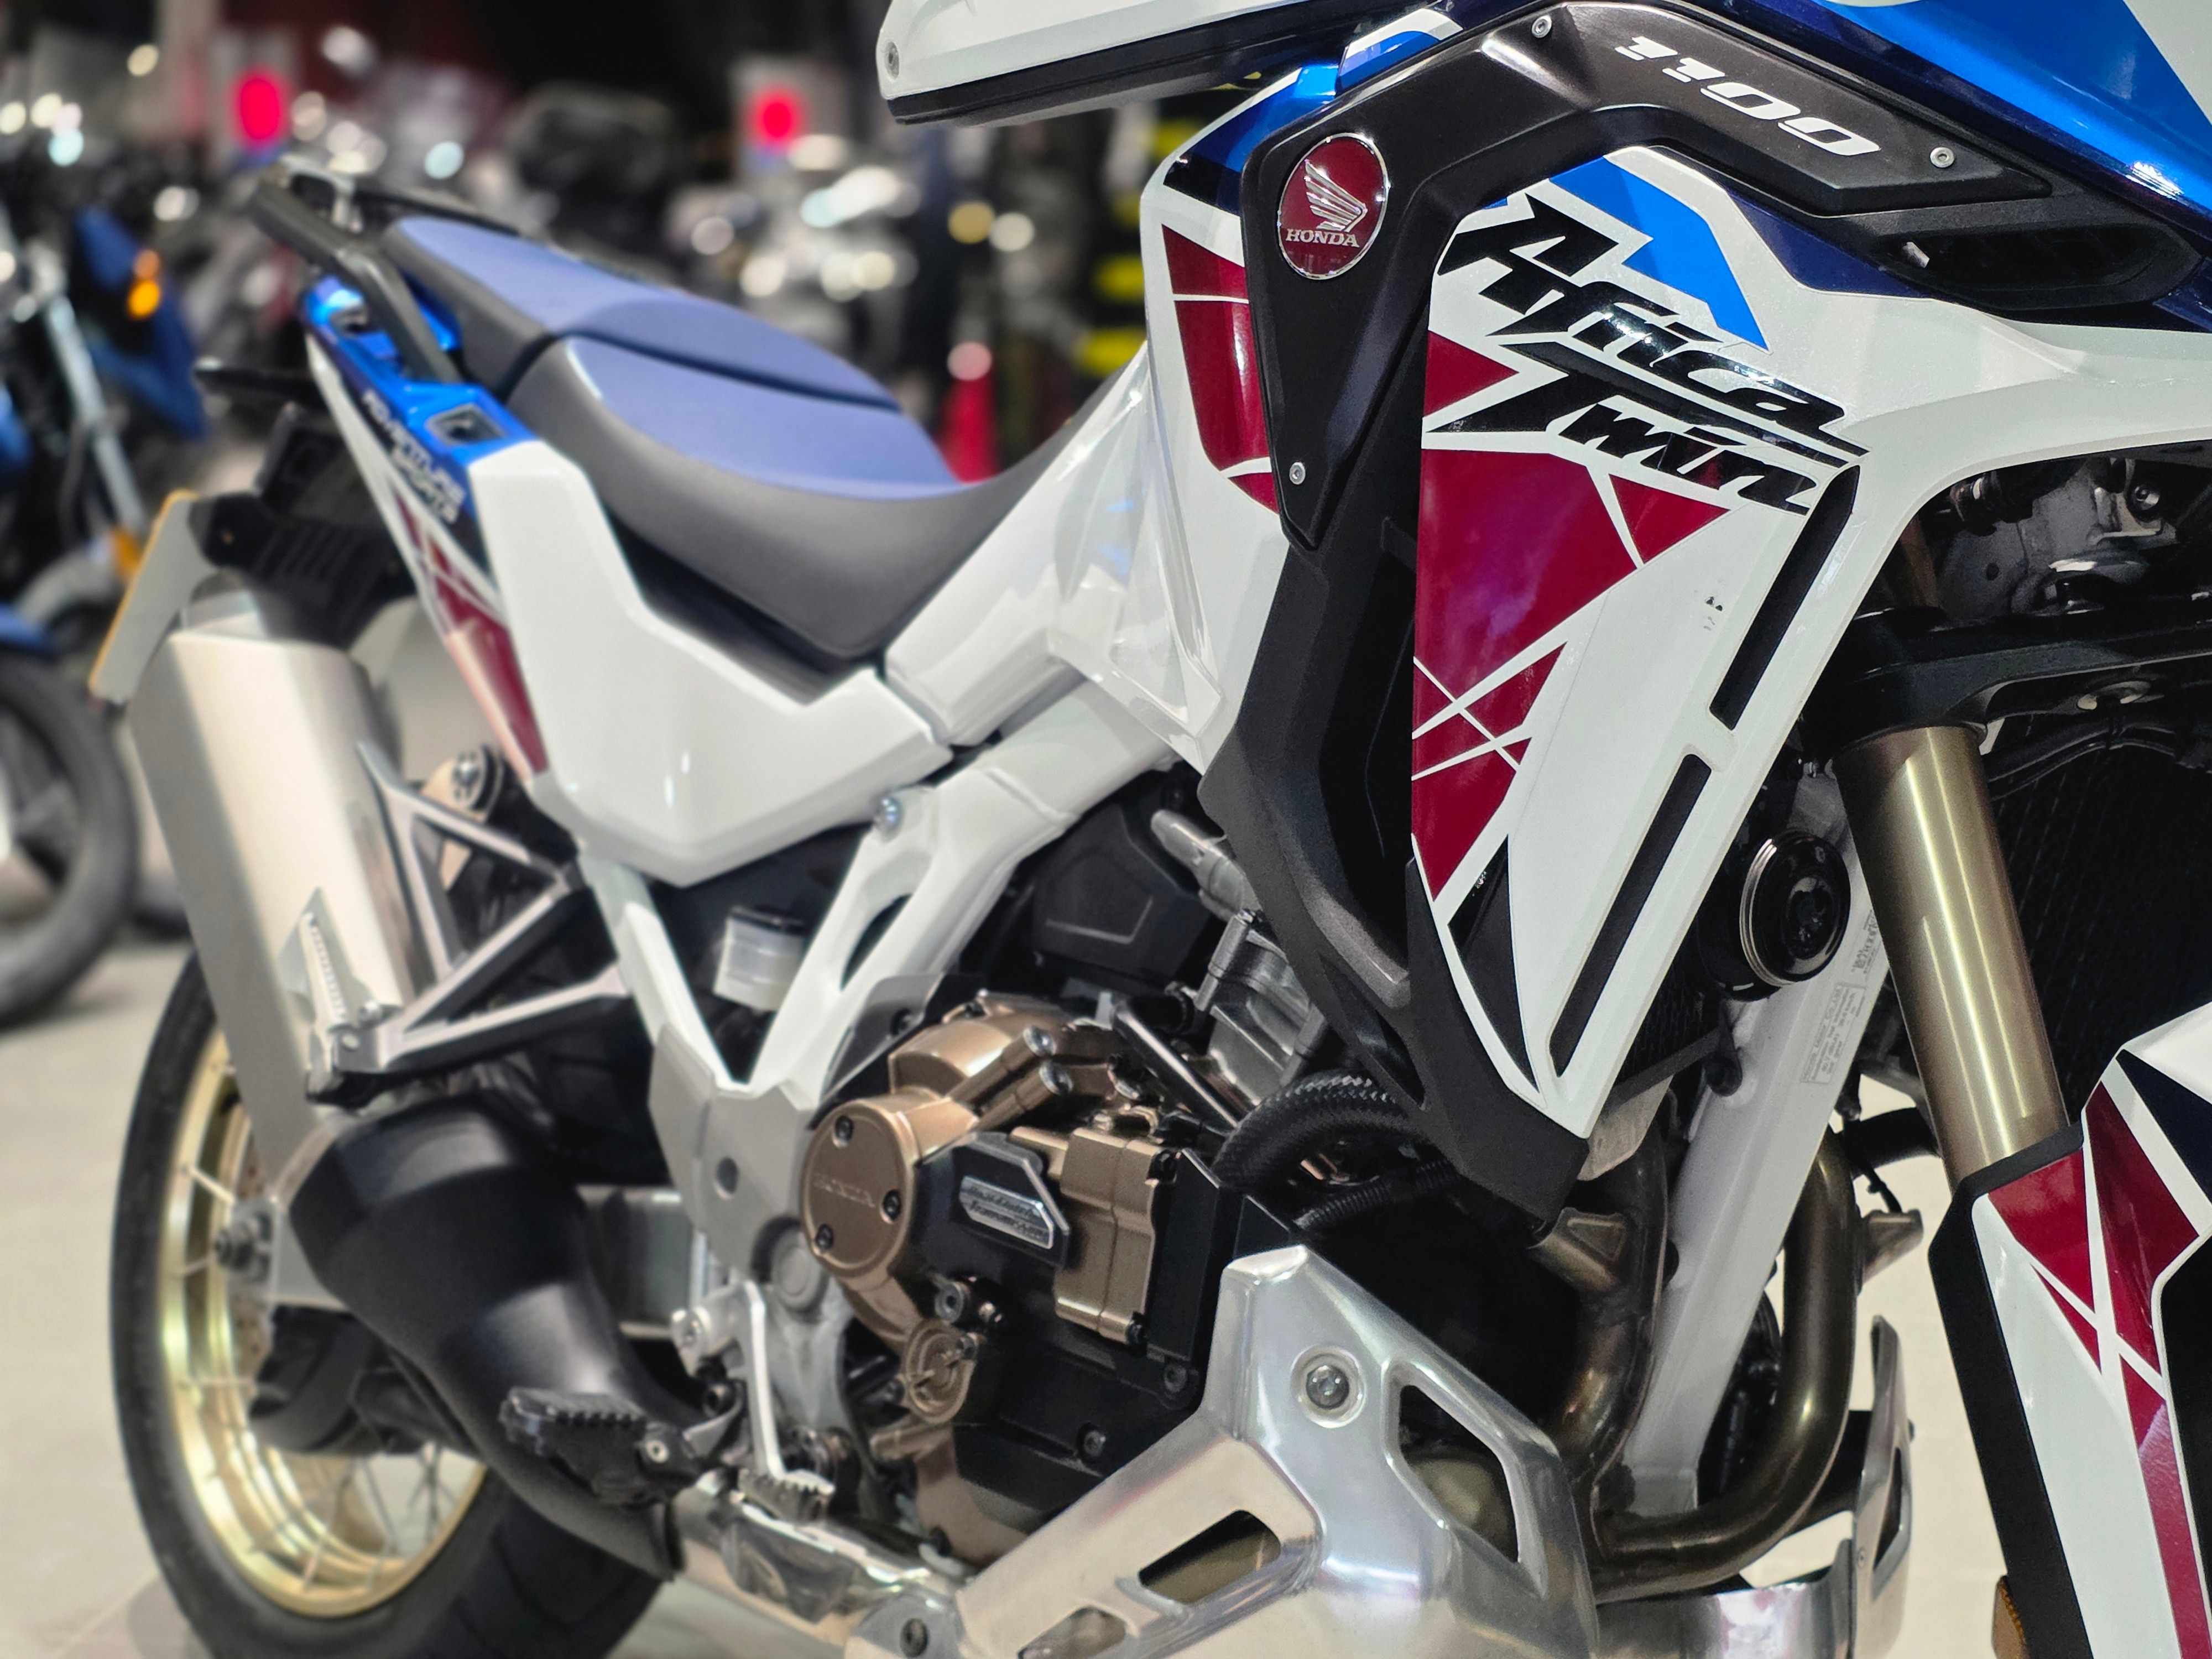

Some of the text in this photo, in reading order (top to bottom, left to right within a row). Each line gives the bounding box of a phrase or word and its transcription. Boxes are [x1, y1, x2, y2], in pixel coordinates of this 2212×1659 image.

[1615, 36, 1880, 156] 1100
[1286, 228, 1360, 248] HONDA
[1438, 193, 1870, 457] Africa
[1427, 342, 1849, 515] Twin
